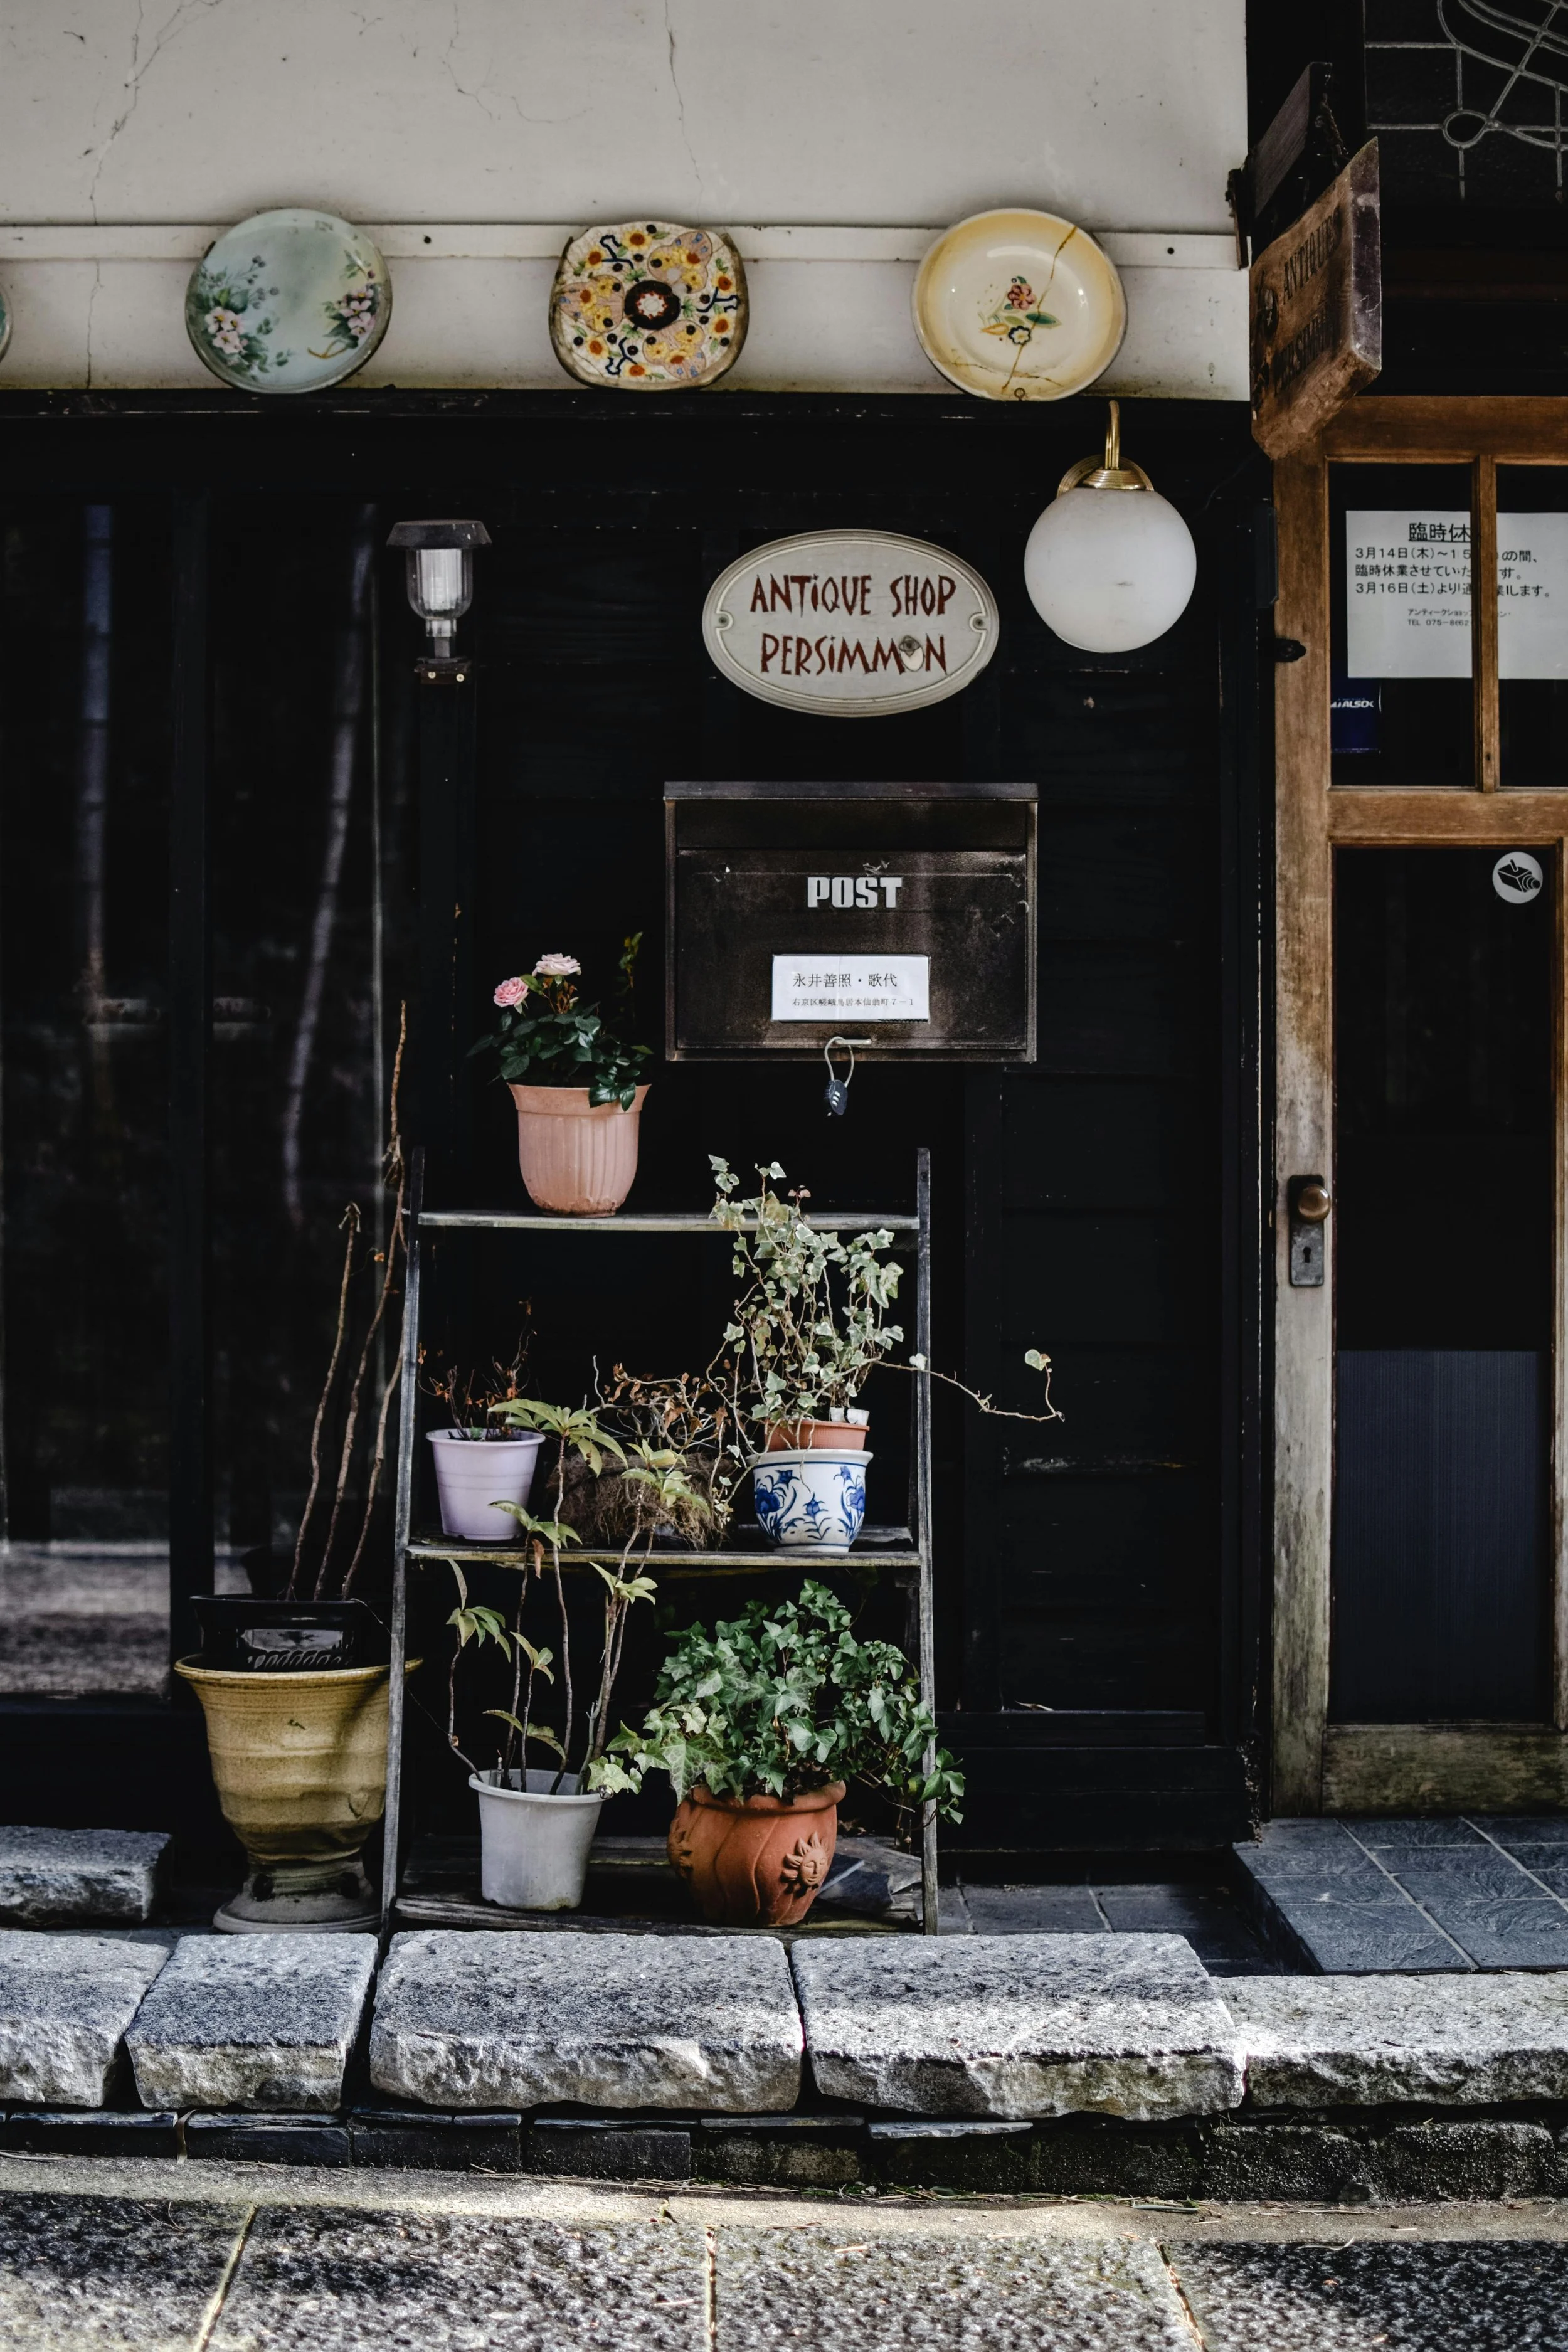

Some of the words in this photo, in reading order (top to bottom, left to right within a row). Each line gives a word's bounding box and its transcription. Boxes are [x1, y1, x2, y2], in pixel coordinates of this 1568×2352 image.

[1409, 522, 1471, 542] 臨時休
[890, 574, 956, 617] SHOP
[807, 877, 903, 908] POST
